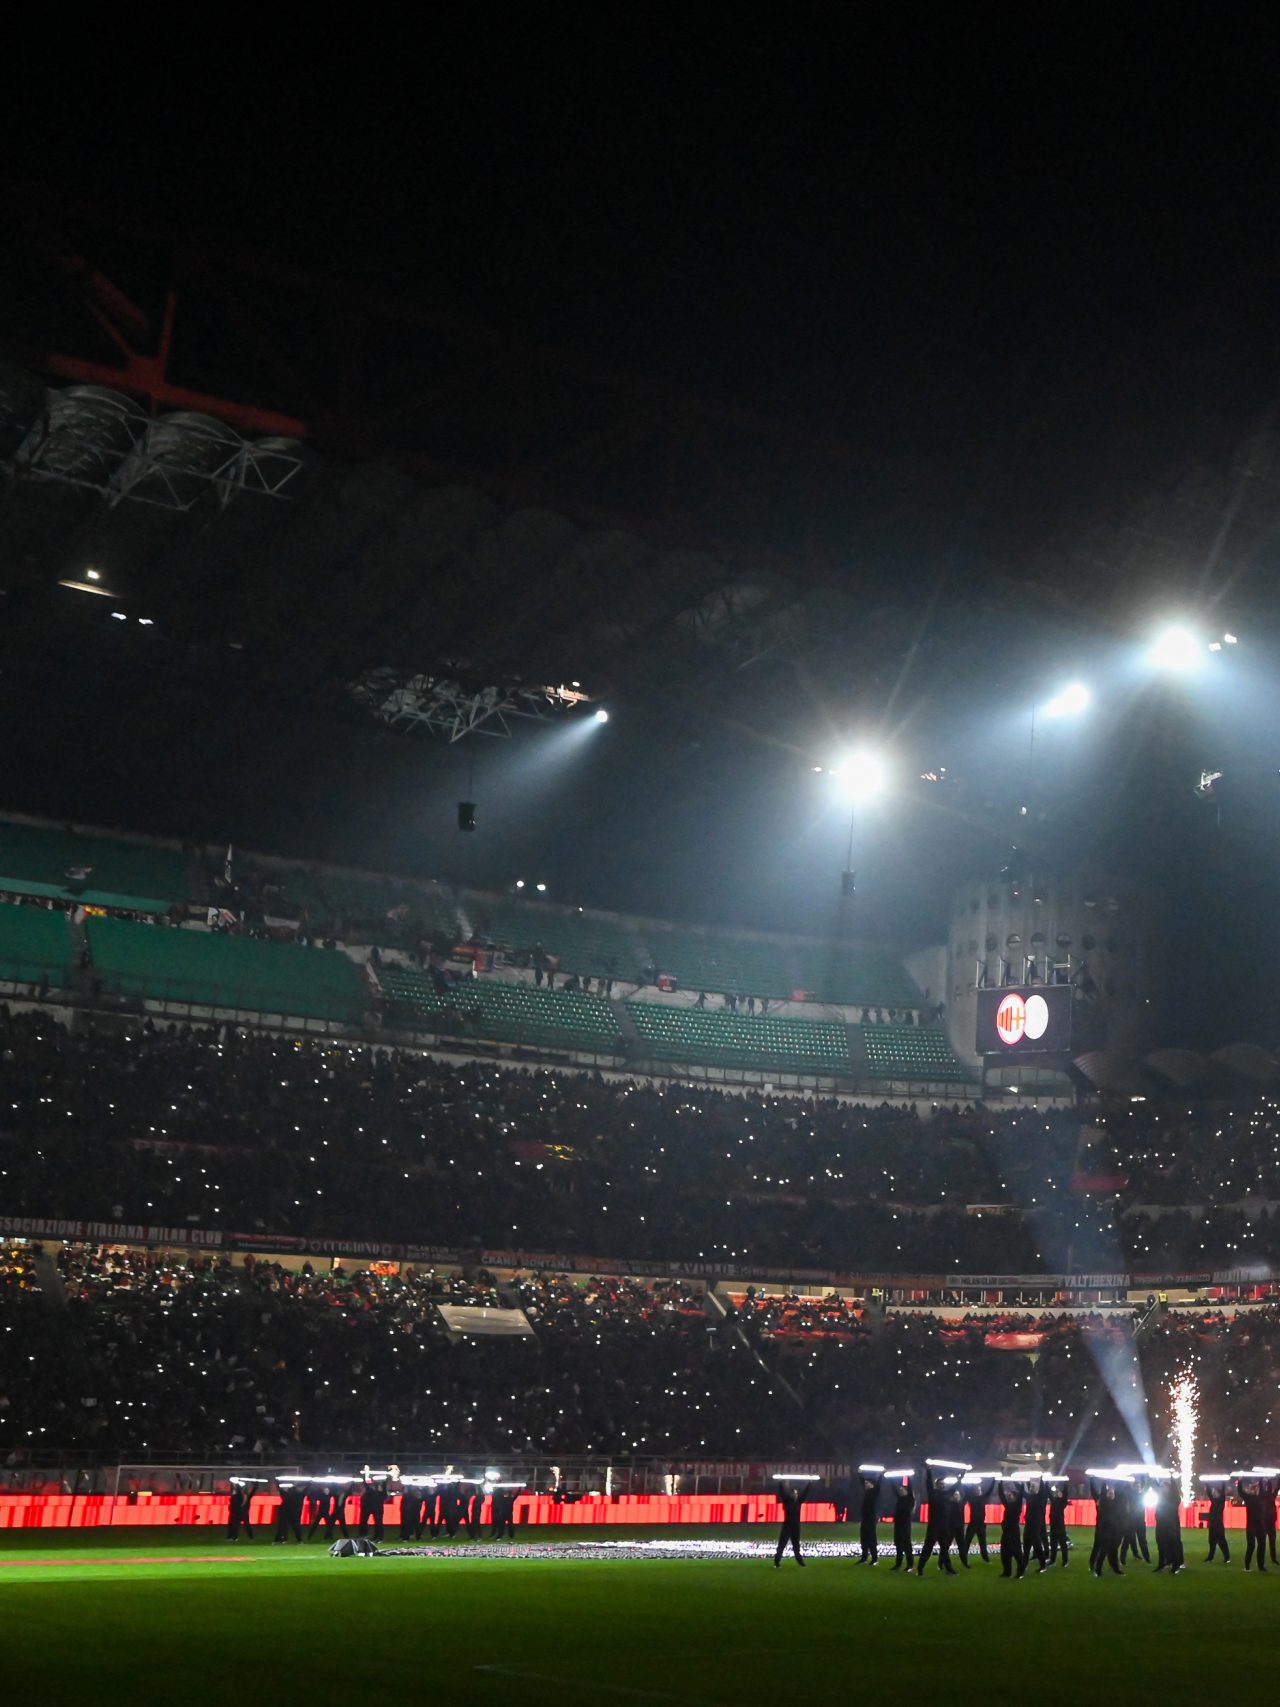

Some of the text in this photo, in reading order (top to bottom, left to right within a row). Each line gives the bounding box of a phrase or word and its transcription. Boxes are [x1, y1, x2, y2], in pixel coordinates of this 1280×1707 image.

[87, 1221, 144, 1239] ITALIANA
[148, 1226, 187, 1243] MILAN
[191, 1229, 223, 1244] CLUB
[1064, 1274, 1130, 1288] VALTIBERINA
